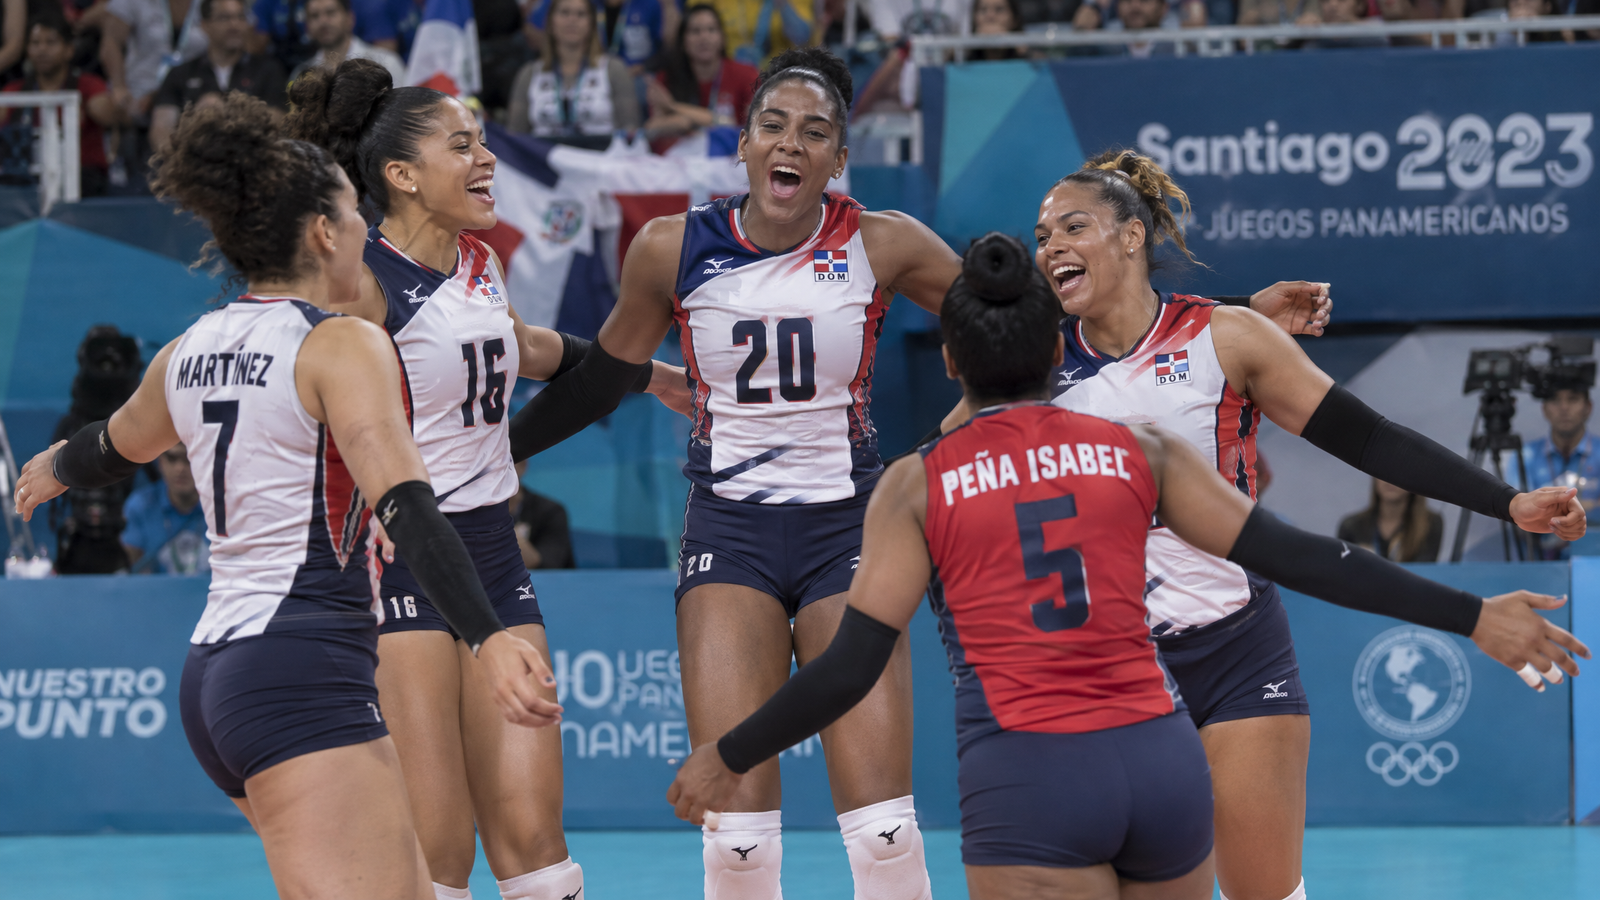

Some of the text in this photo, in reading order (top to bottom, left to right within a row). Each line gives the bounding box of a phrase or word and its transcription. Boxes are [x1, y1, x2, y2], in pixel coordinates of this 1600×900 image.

[1137, 112, 1594, 190] Santiago 2023
[1202, 202, 1570, 240] JUEGOS PANAMERICANOS
[818, 272, 846, 281] DOM
[176, 344, 274, 390] MARTÍNEZ
[732, 315, 817, 404] 20
[1159, 372, 1187, 384] DOM
[461, 337, 508, 428] 16
[202, 399, 240, 537] 7
[941, 450, 1020, 506] PEÑA
[686, 553, 713, 577] 20
[1014, 493, 1092, 633] 5
[390, 596, 418, 619] 16
[0, 666, 167, 699] NUESTRO
[0, 697, 168, 740] PUNTO
